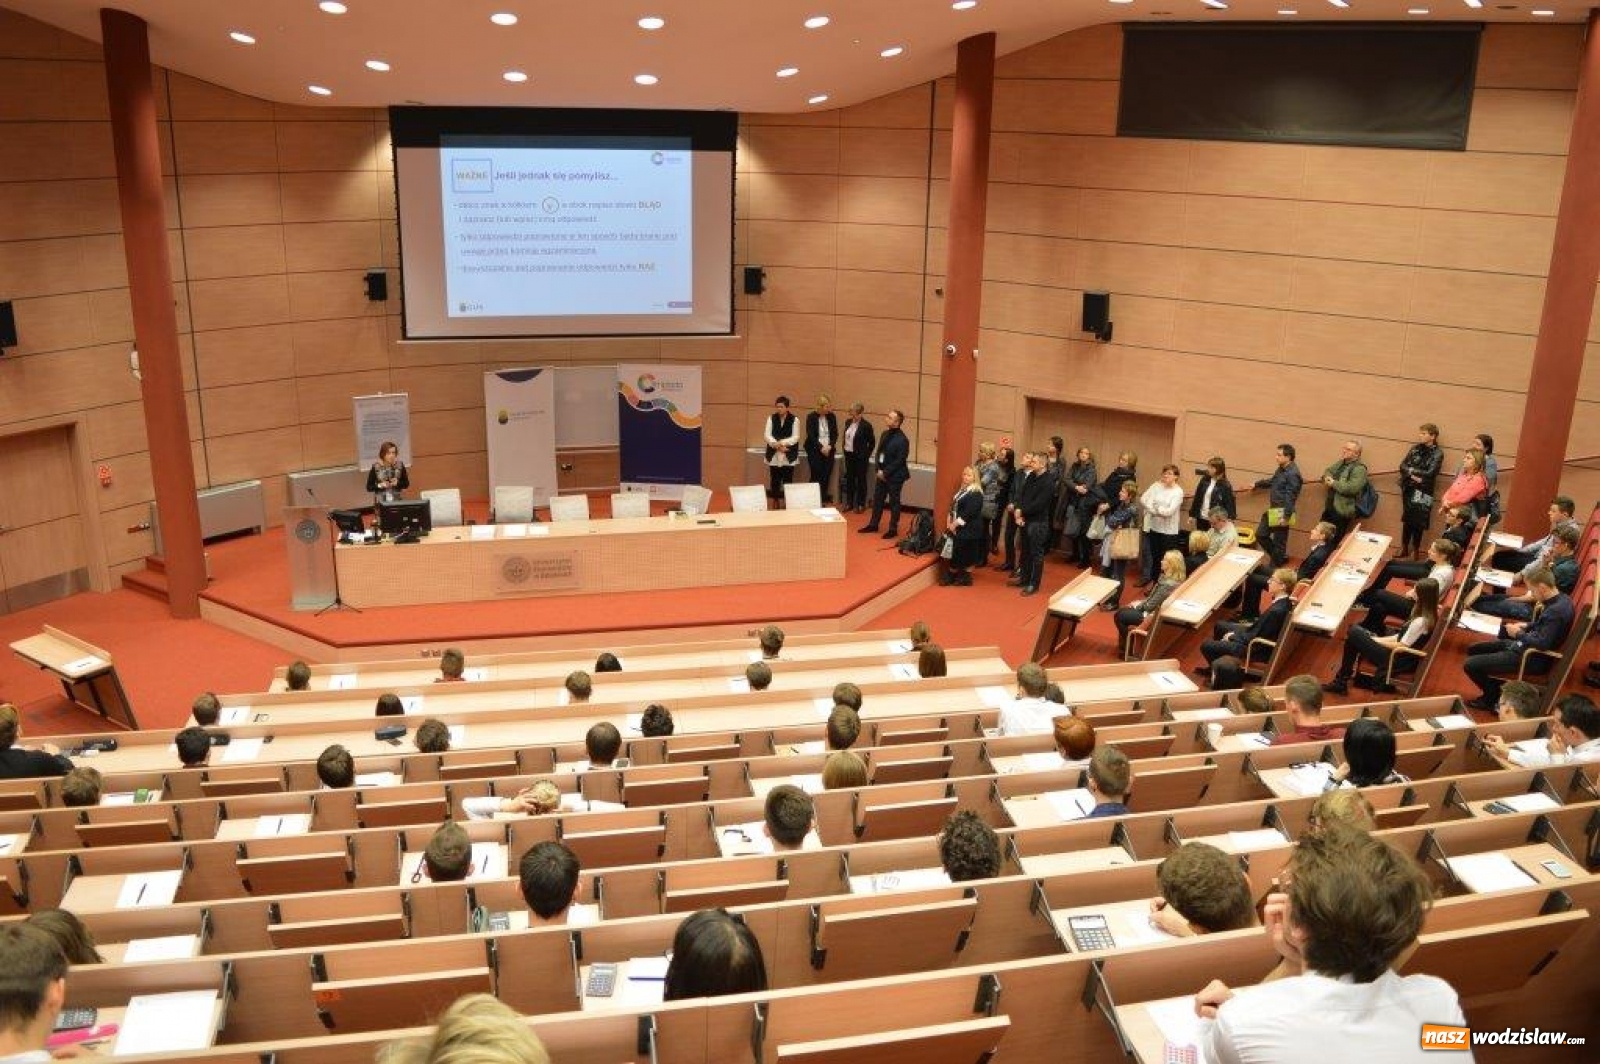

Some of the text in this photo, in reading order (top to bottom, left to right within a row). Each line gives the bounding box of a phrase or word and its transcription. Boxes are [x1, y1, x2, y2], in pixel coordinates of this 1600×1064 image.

[494, 170, 516, 180] Jeśli
[518, 170, 549, 182] jednak
[553, 170, 567, 182] się
